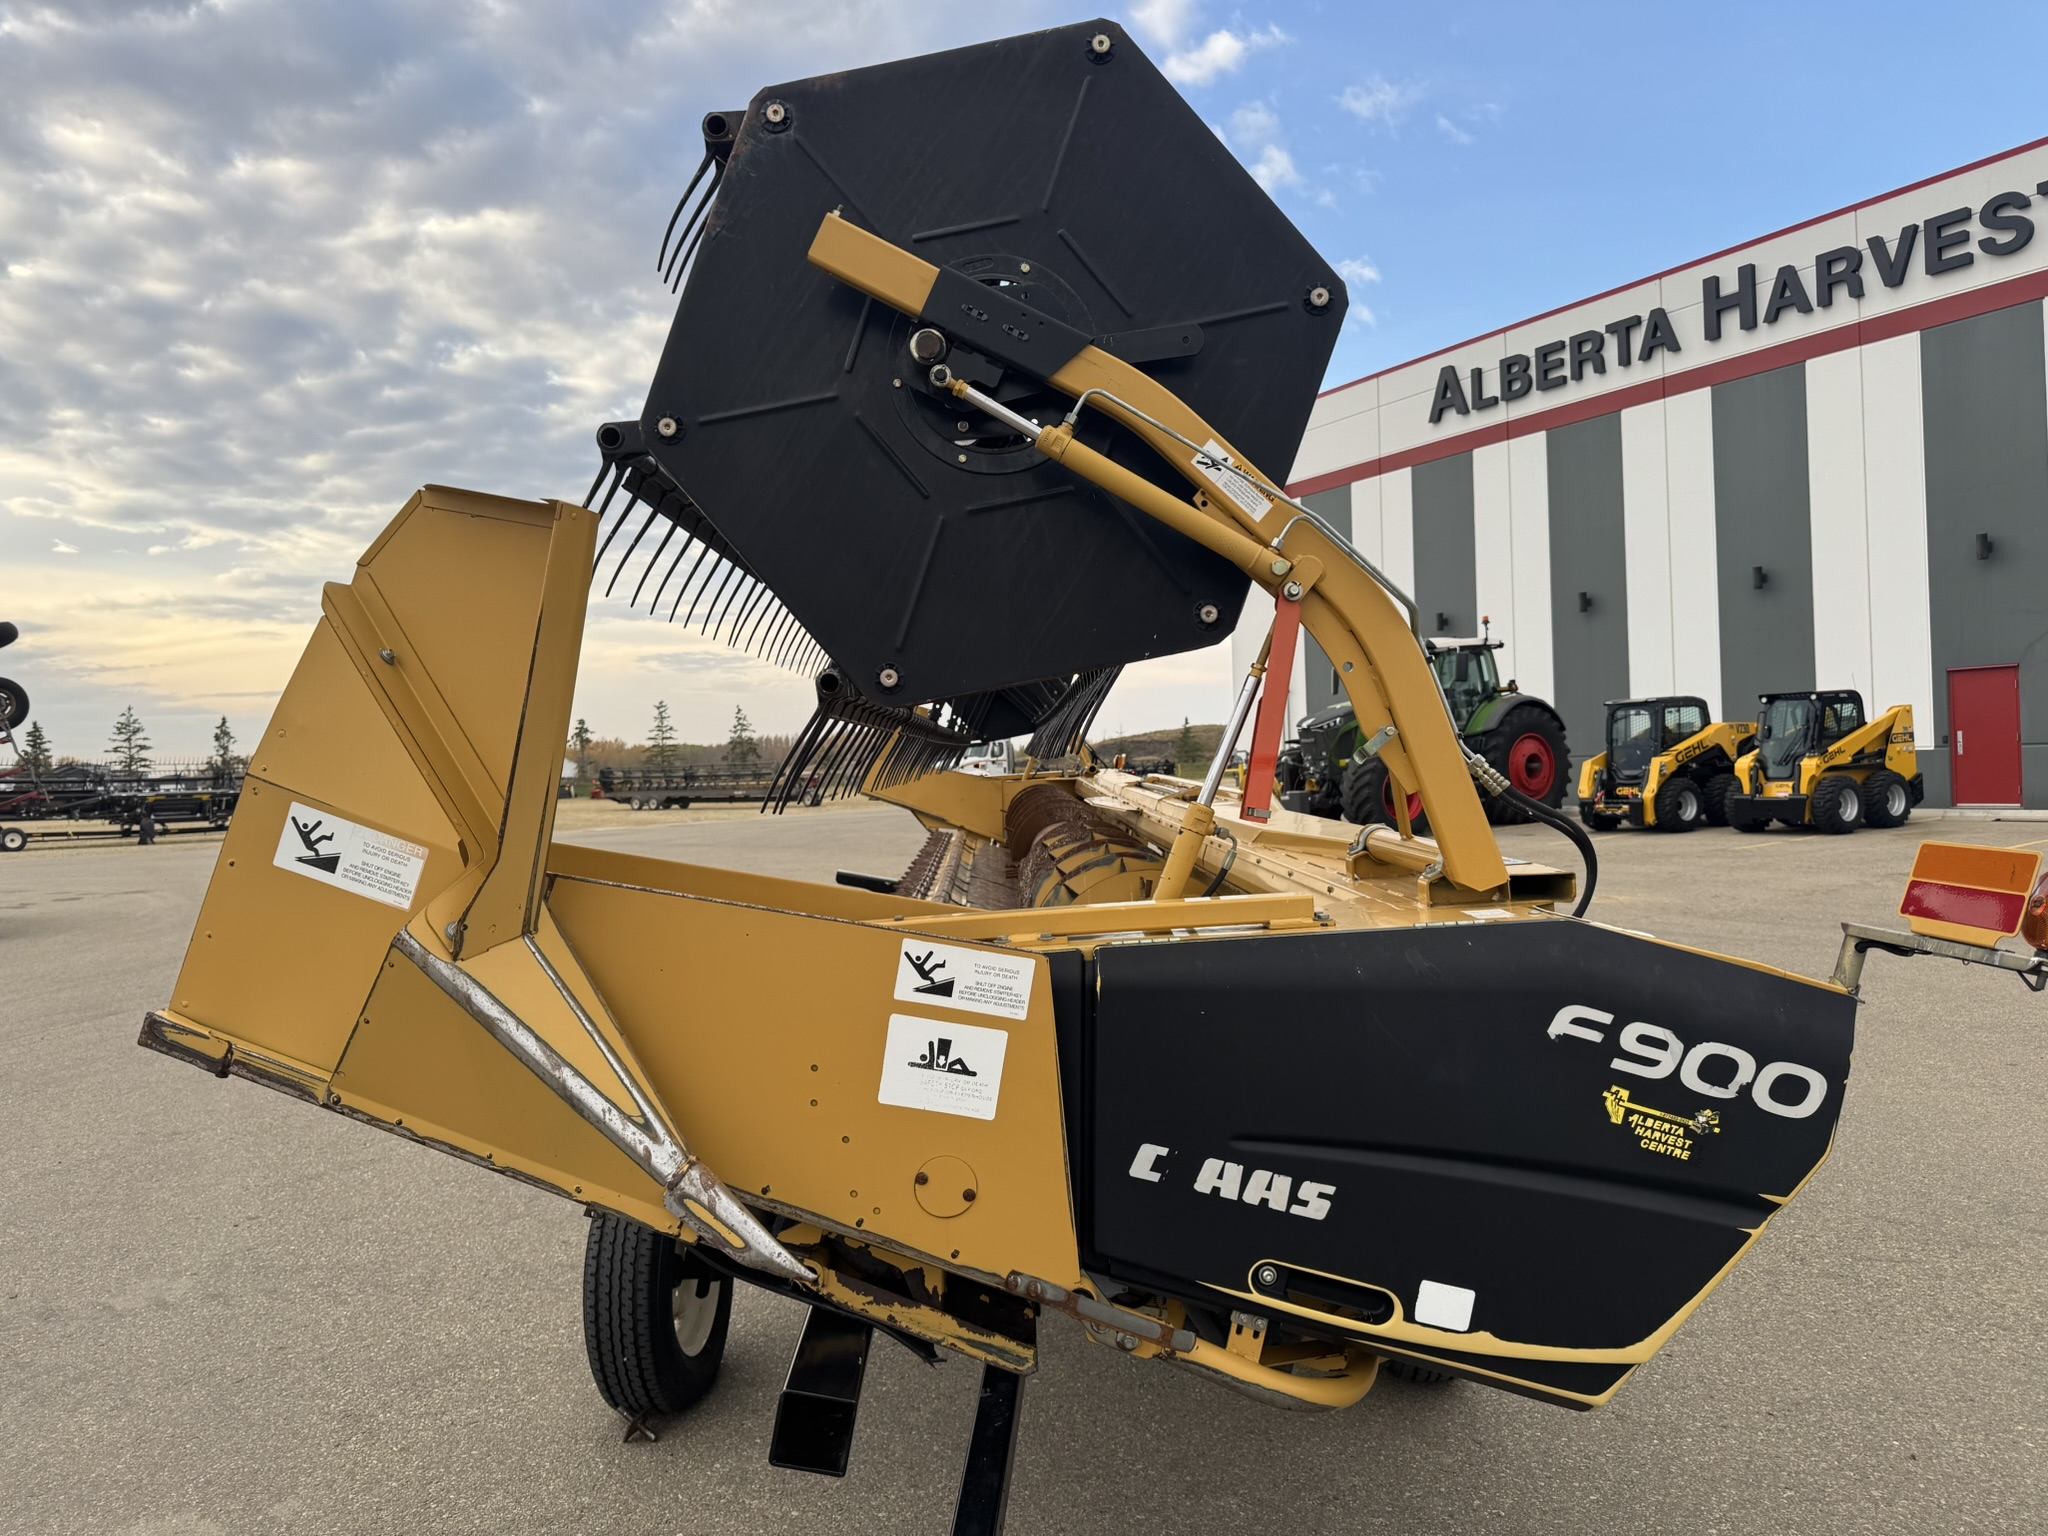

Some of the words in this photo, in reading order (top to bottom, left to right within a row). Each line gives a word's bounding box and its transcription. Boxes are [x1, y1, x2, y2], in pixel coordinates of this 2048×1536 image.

[1428, 307, 1681, 424] ALBERTA
[1702, 179, 2048, 341] HARVES
[1892, 733, 1912, 742] GEHL
[1675, 739, 1710, 764] GEHL
[1822, 746, 1846, 764] GEHL
[1616, 786, 1642, 796] GEHL
[371, 845, 386, 854] AVOID
[388, 850, 411, 862] SERIOUS
[374, 833, 423, 857] DANGER
[362, 848, 380, 858] INJURY
[390, 858, 408, 867] DEATH
[360, 866, 379, 877] REMOVE
[380, 874, 400, 884] STARTER
[361, 860, 374, 869] SHUT
[384, 868, 402, 878] ENGINE
[342, 868, 361, 877] BEFORE
[362, 874, 393, 889] UNCLOGGING
[393, 884, 412, 895] HEADER
[348, 876, 367, 886] MAKING
[377, 886, 411, 901] ADJUSTMENTS
[982, 964, 997, 972] AVOID
[998, 966, 1020, 975] SERIOUS
[1546, 1004, 1828, 1120] F900
[1628, 1114, 1684, 1136] ALBERTA
[1634, 1126, 1693, 1149] HARVEST
[1640, 1138, 1691, 1160] CENTRE
[1129, 1143, 1337, 1220] CAAS
